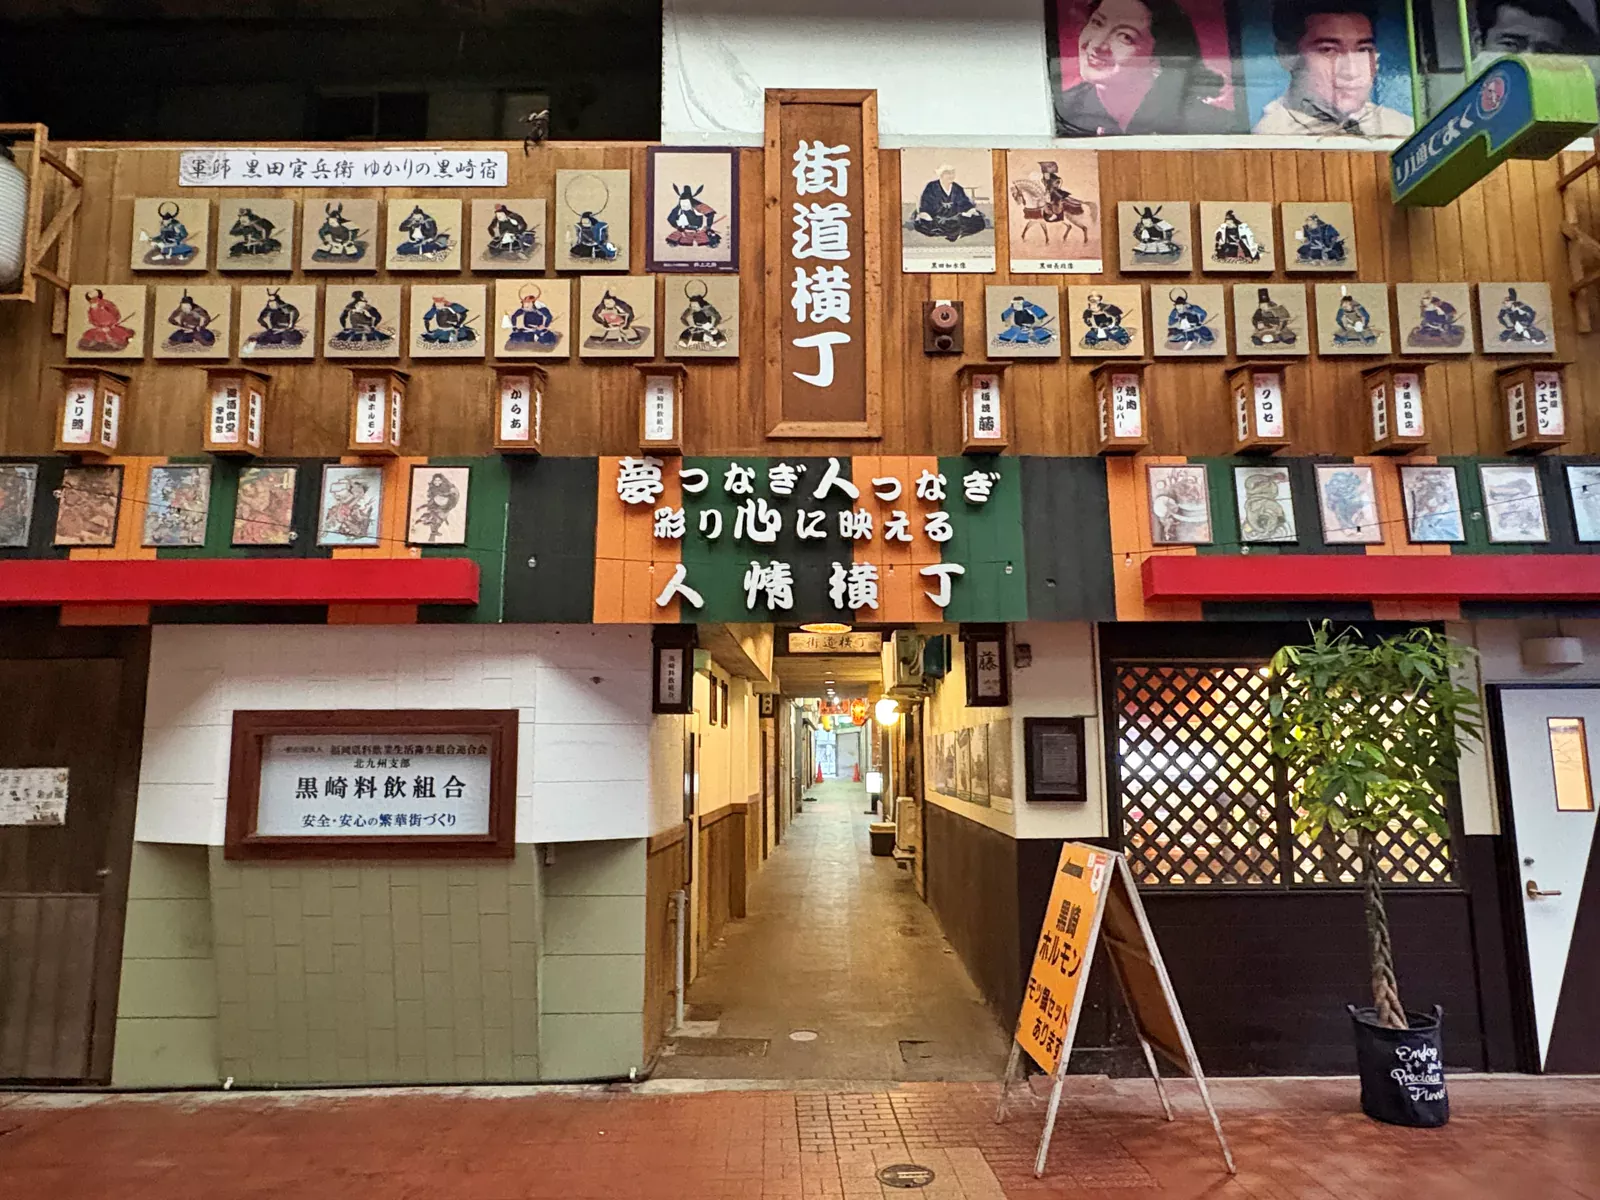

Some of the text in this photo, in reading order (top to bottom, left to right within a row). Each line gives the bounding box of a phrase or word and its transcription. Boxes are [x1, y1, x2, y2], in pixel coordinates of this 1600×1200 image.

[191, 157, 498, 180] 軍師 黒田官兵衛 ゆかりの黒崎宿
[791, 140, 851, 388] 街道横丁
[510, 389, 521, 429] からあ
[1125, 385, 1137, 411] 焼肉
[1261, 389, 1274, 423] クロセ
[1537, 380, 1549, 428] ウエマツ
[616, 456, 1001, 504] 夢つなぎ人つなぎ
[653, 498, 954, 543] 彩り心に映える
[655, 560, 966, 611] 人情横丁
[806, 636, 868, 649] 街道横丁
[978, 651, 998, 671] 藤
[353, 758, 411, 769] 北九州支部
[295, 775, 467, 799] 黒崎料飲組合
[302, 814, 457, 828] 安全・安心の繁華街づくり
[1055, 899, 1082, 940] 黒崎
[1038, 929, 1082, 978] ホルモン
[1028, 977, 1069, 1029] モツ鍋セット
[1032, 1016, 1063, 1060] あります
[1395, 1043, 1438, 1062] Enjoy
